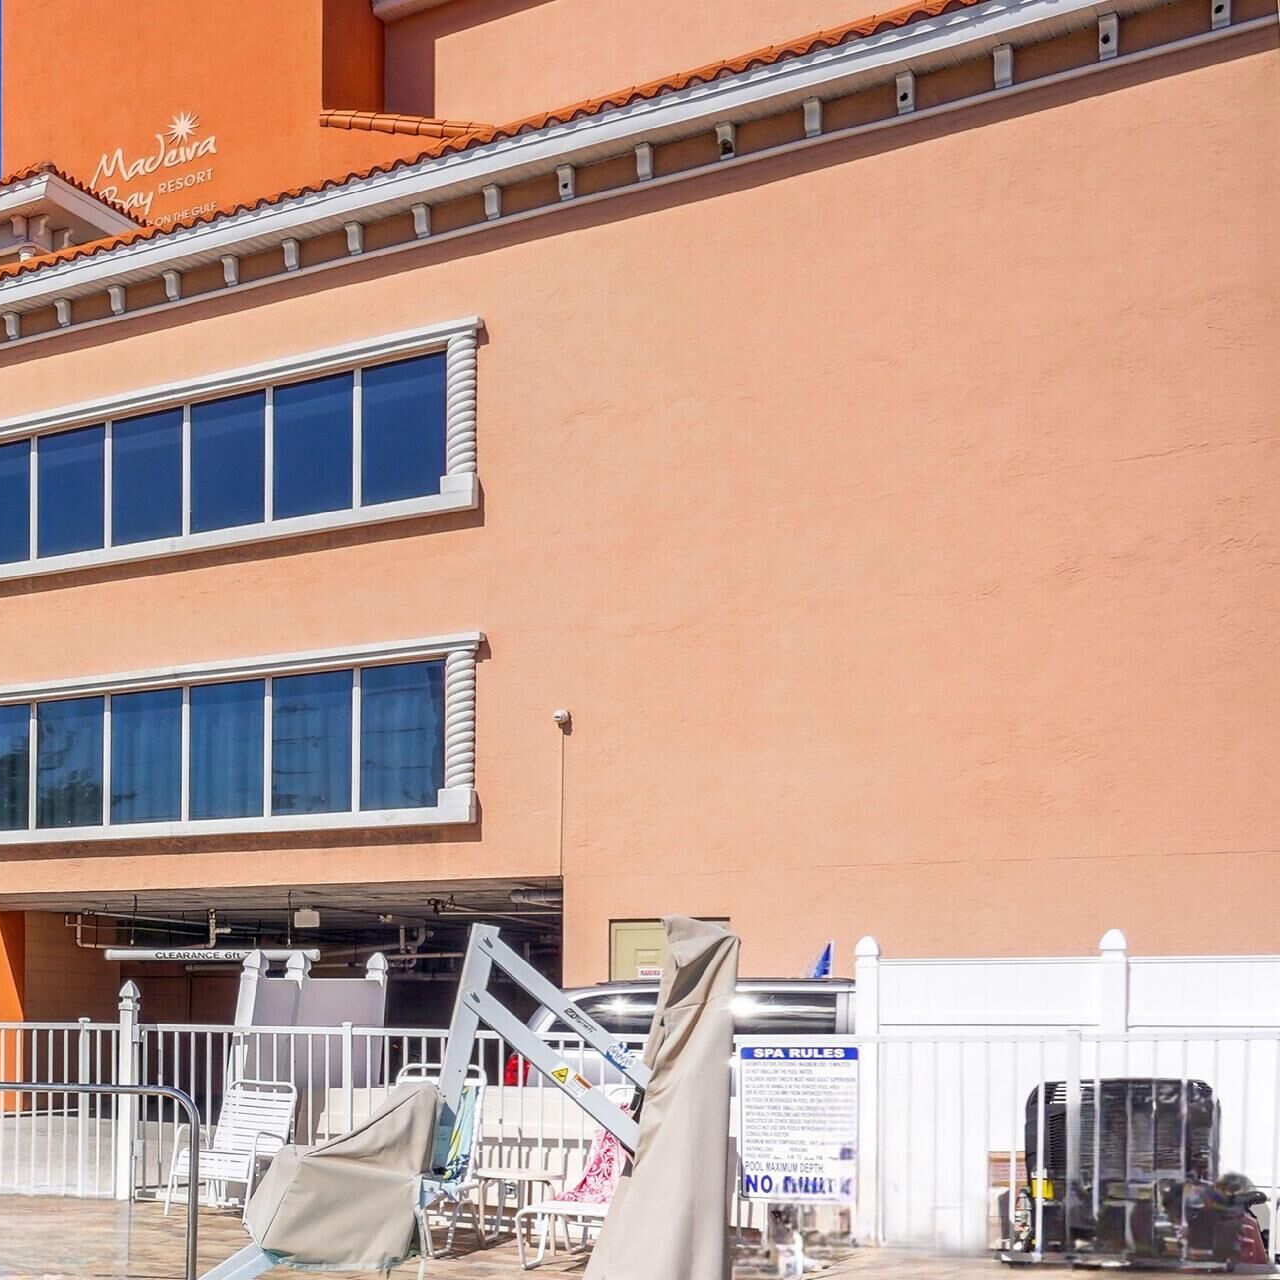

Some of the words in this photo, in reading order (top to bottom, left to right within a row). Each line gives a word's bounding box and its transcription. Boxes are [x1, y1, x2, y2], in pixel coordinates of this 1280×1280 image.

[90, 134, 217, 188] Madeira
[158, 168, 214, 195] RESORT
[156, 216, 171, 226] ON
[173, 209, 190, 220] THE
[191, 201, 217, 216] GULF
[155, 952, 220, 960] CLEARANCE
[753, 1048, 785, 1058] SPA
[789, 1048, 846, 1059] RULES
[745, 1161, 764, 1171] POOL
[765, 1162, 798, 1172] MAXIMUM
[745, 1174, 773, 1193] NO
